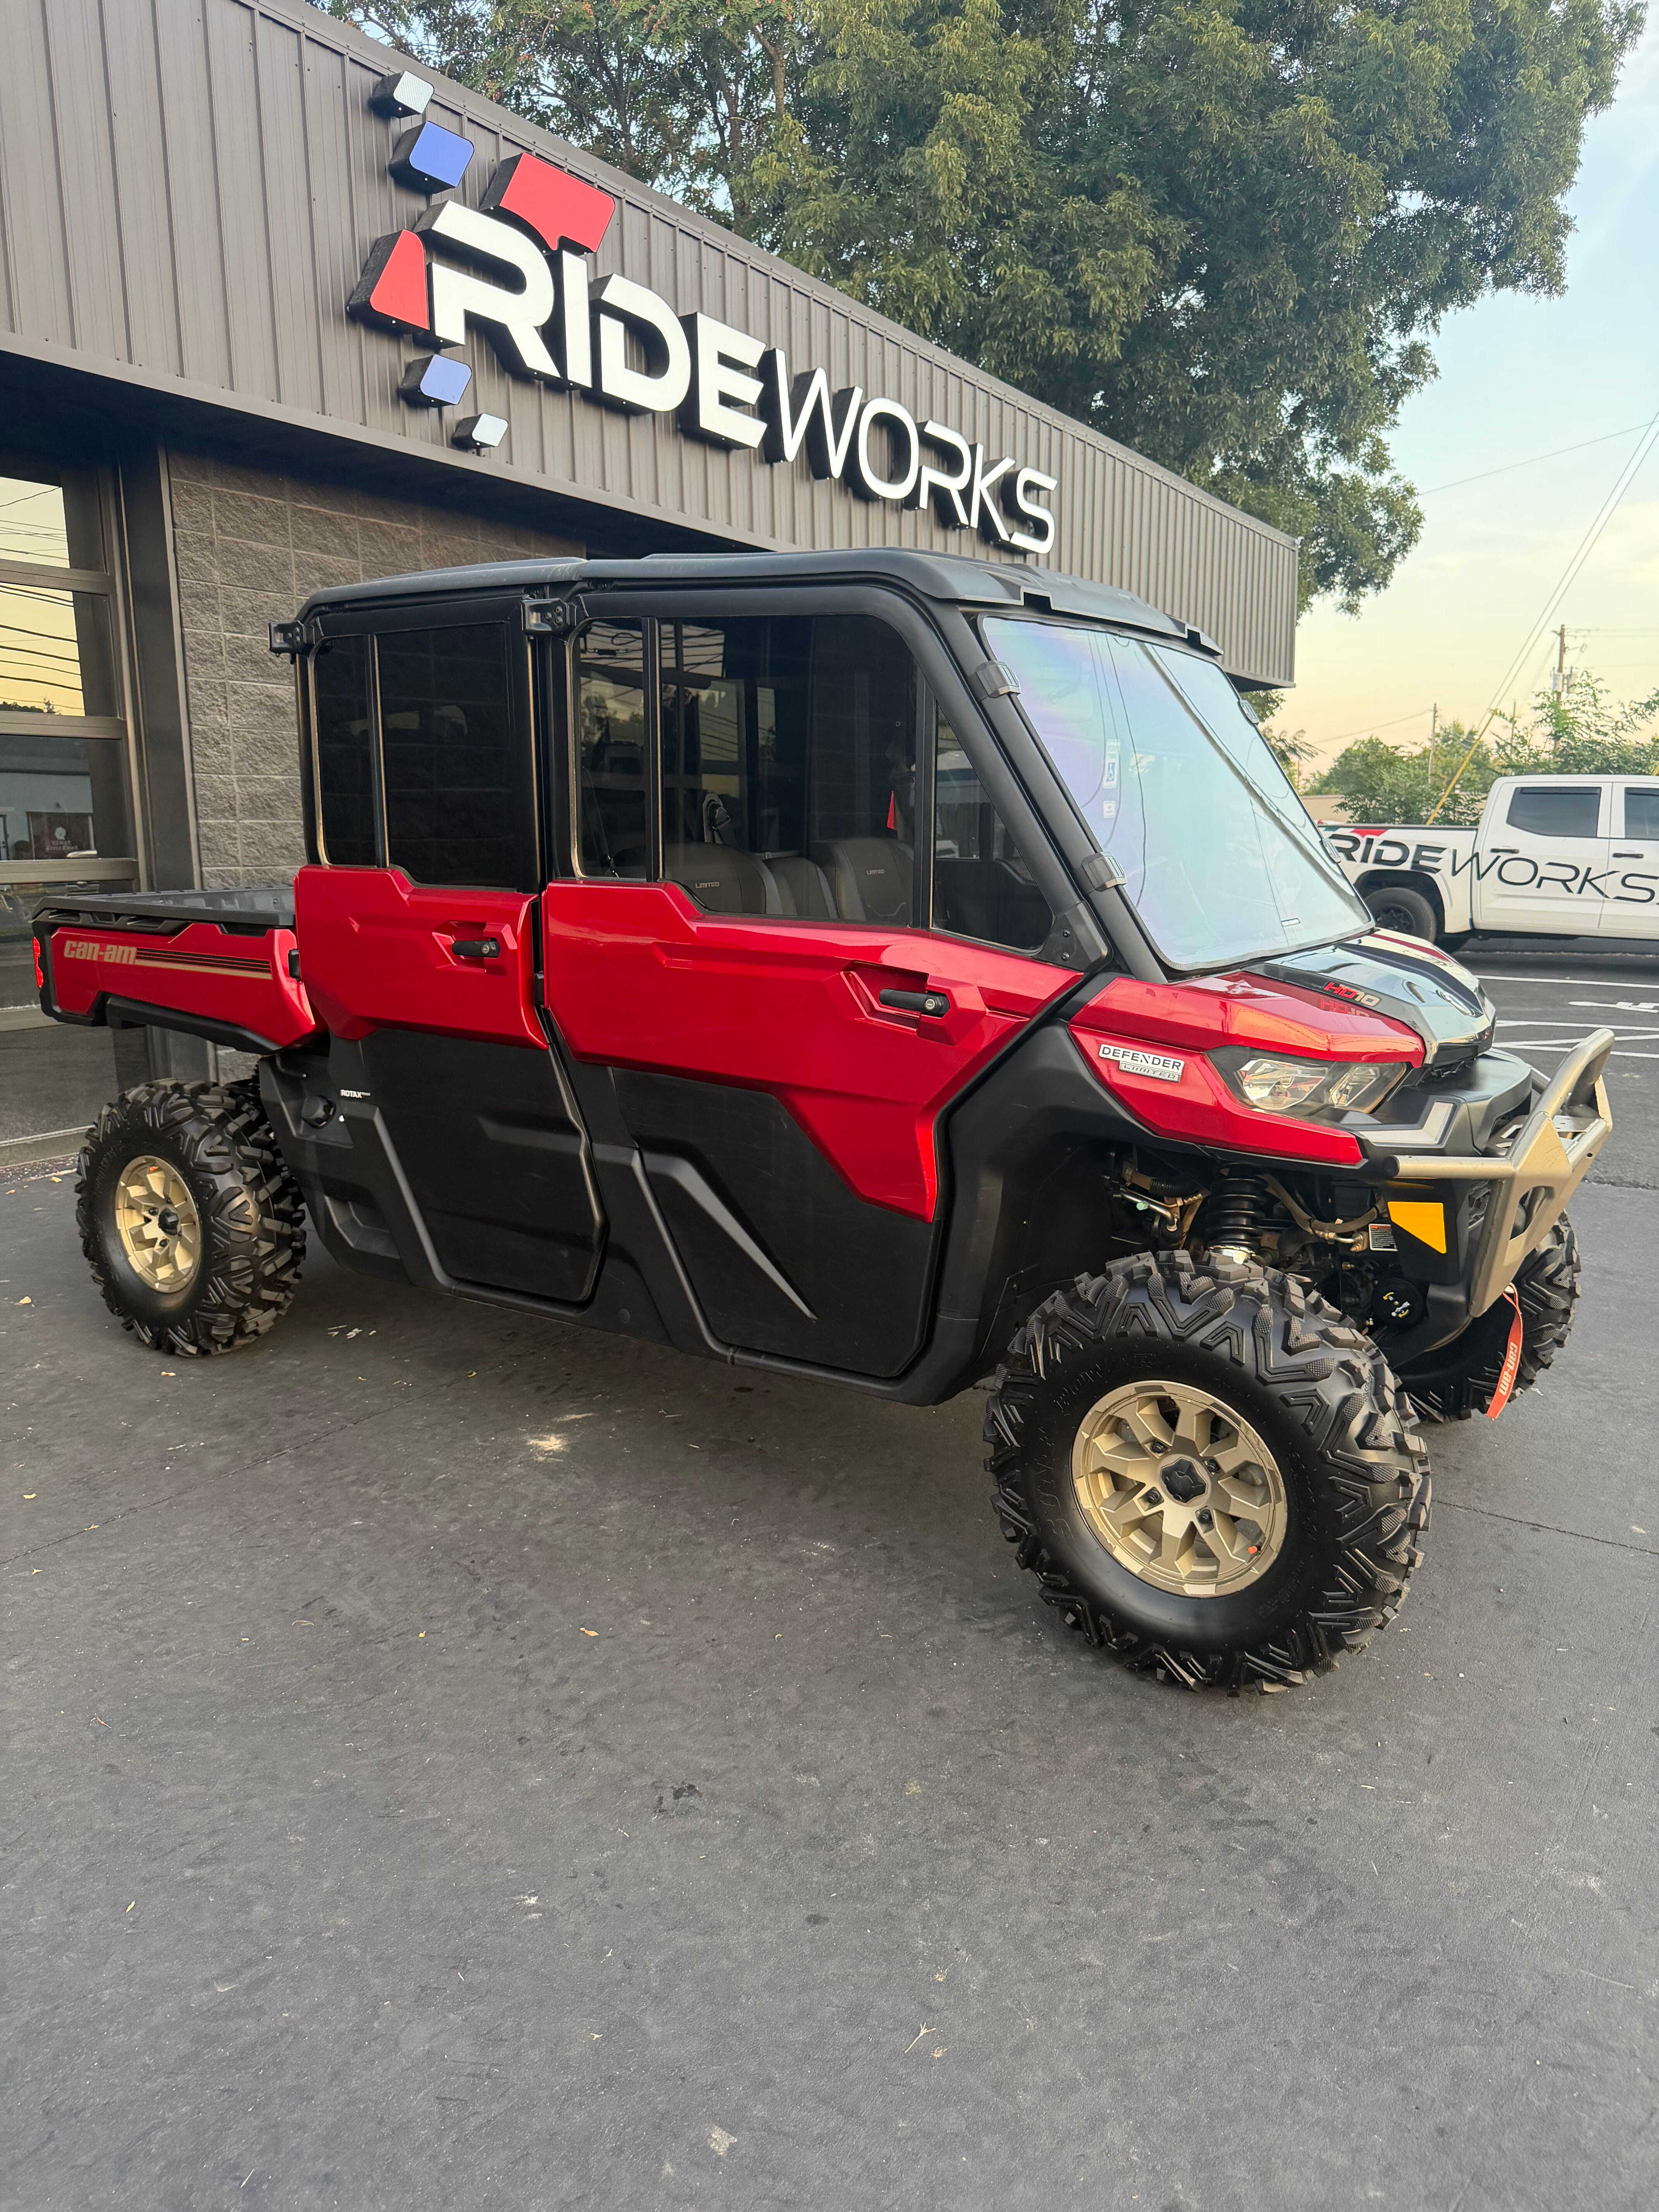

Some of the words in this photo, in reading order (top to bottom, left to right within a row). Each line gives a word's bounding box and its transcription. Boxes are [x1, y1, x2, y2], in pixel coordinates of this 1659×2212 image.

[431, 199, 1058, 554] RIDEWORKS
[63, 940, 137, 965] can-am
[1324, 981, 1381, 1007] HD10
[1101, 1046, 1182, 1070] DEFENDER
[1123, 1065, 1176, 1079] LIMITED
[340, 1089, 362, 1099] ROTAX
[1498, 1341, 1518, 1396] can-am
